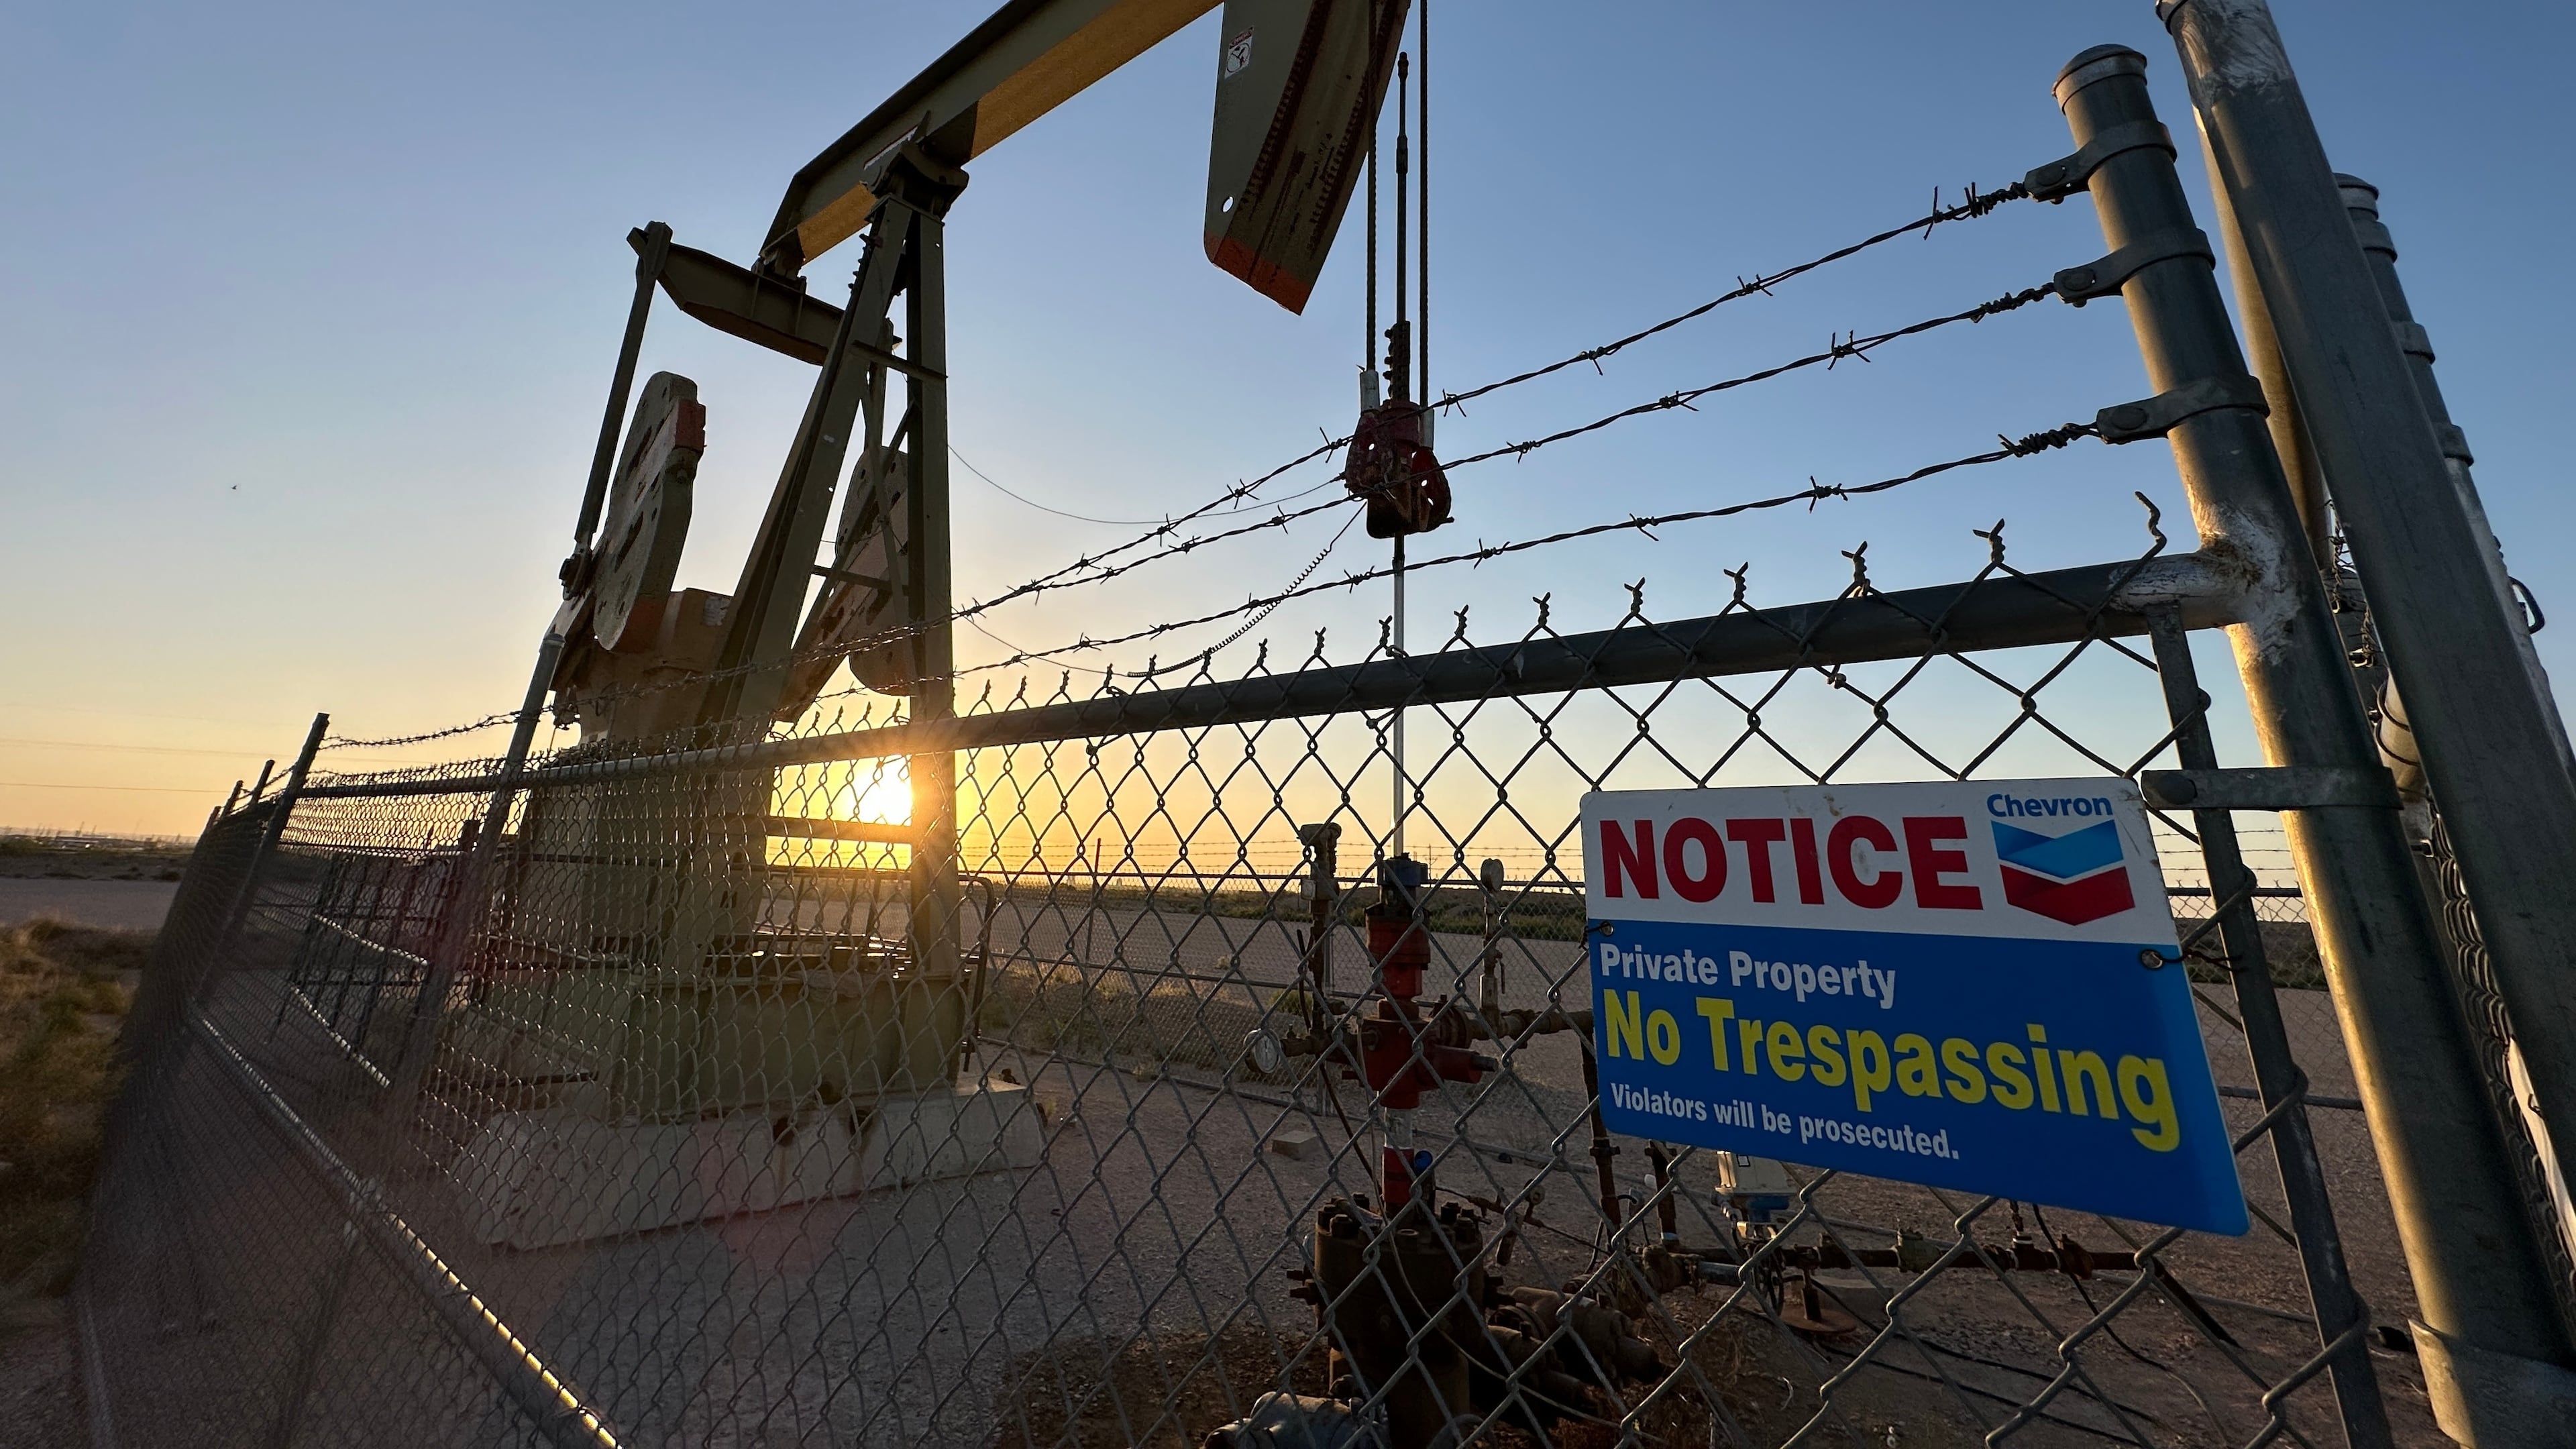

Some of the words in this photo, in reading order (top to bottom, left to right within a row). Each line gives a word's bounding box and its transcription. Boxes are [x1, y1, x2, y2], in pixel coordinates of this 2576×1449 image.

[1986, 793, 2113, 818] Chevron
[1599, 815, 1984, 910] NOTICE
[1600, 943, 1719, 985] Private
[1729, 951, 1896, 1010] Property
[1603, 988, 1681, 1066] No
[1696, 997, 2180, 1152] Trespassing
[1611, 1082, 1707, 1122] Violators
[1713, 1101, 1756, 1129] will
[1762, 1104, 1792, 1134] be
[1799, 1116, 1960, 1161] prosecuted.
